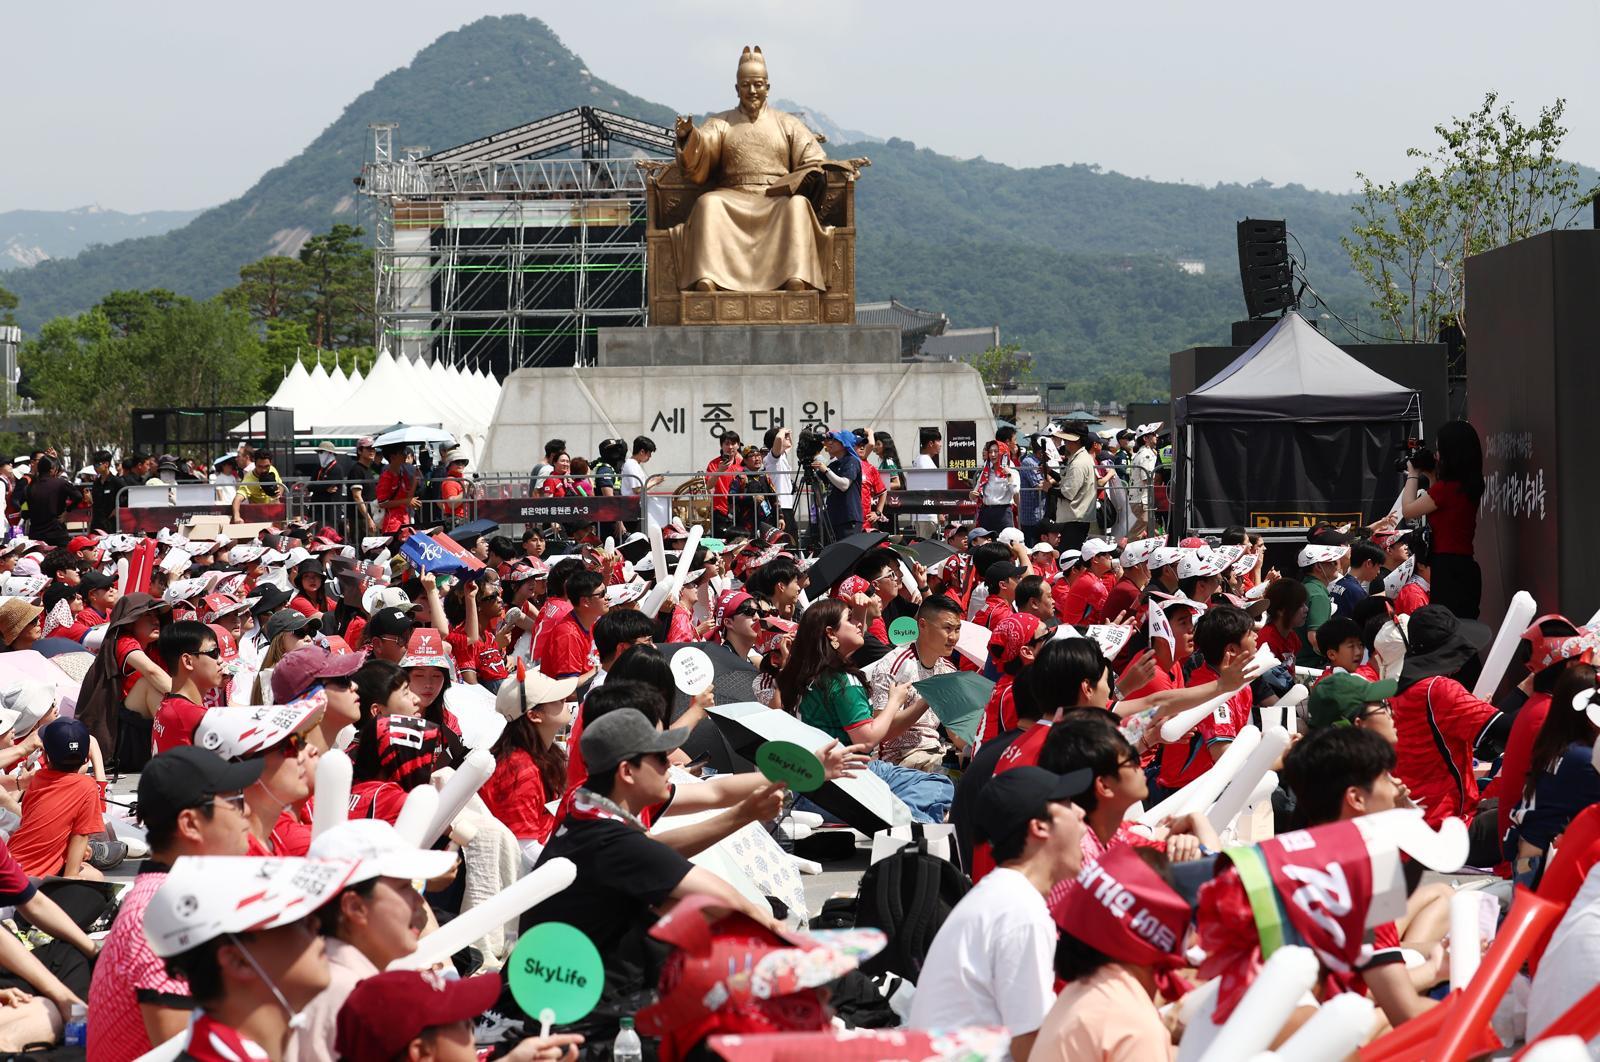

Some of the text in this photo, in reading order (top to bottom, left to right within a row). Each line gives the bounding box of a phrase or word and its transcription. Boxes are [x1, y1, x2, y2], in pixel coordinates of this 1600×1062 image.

[650, 401, 835, 438] 세종대왕
[521, 507, 549, 516] 붉은악마
[573, 506, 589, 515] A-3
[893, 629, 916, 637] SkyLife
[767, 752, 813, 779] SkyLife
[523, 957, 588, 988] SkyLife
